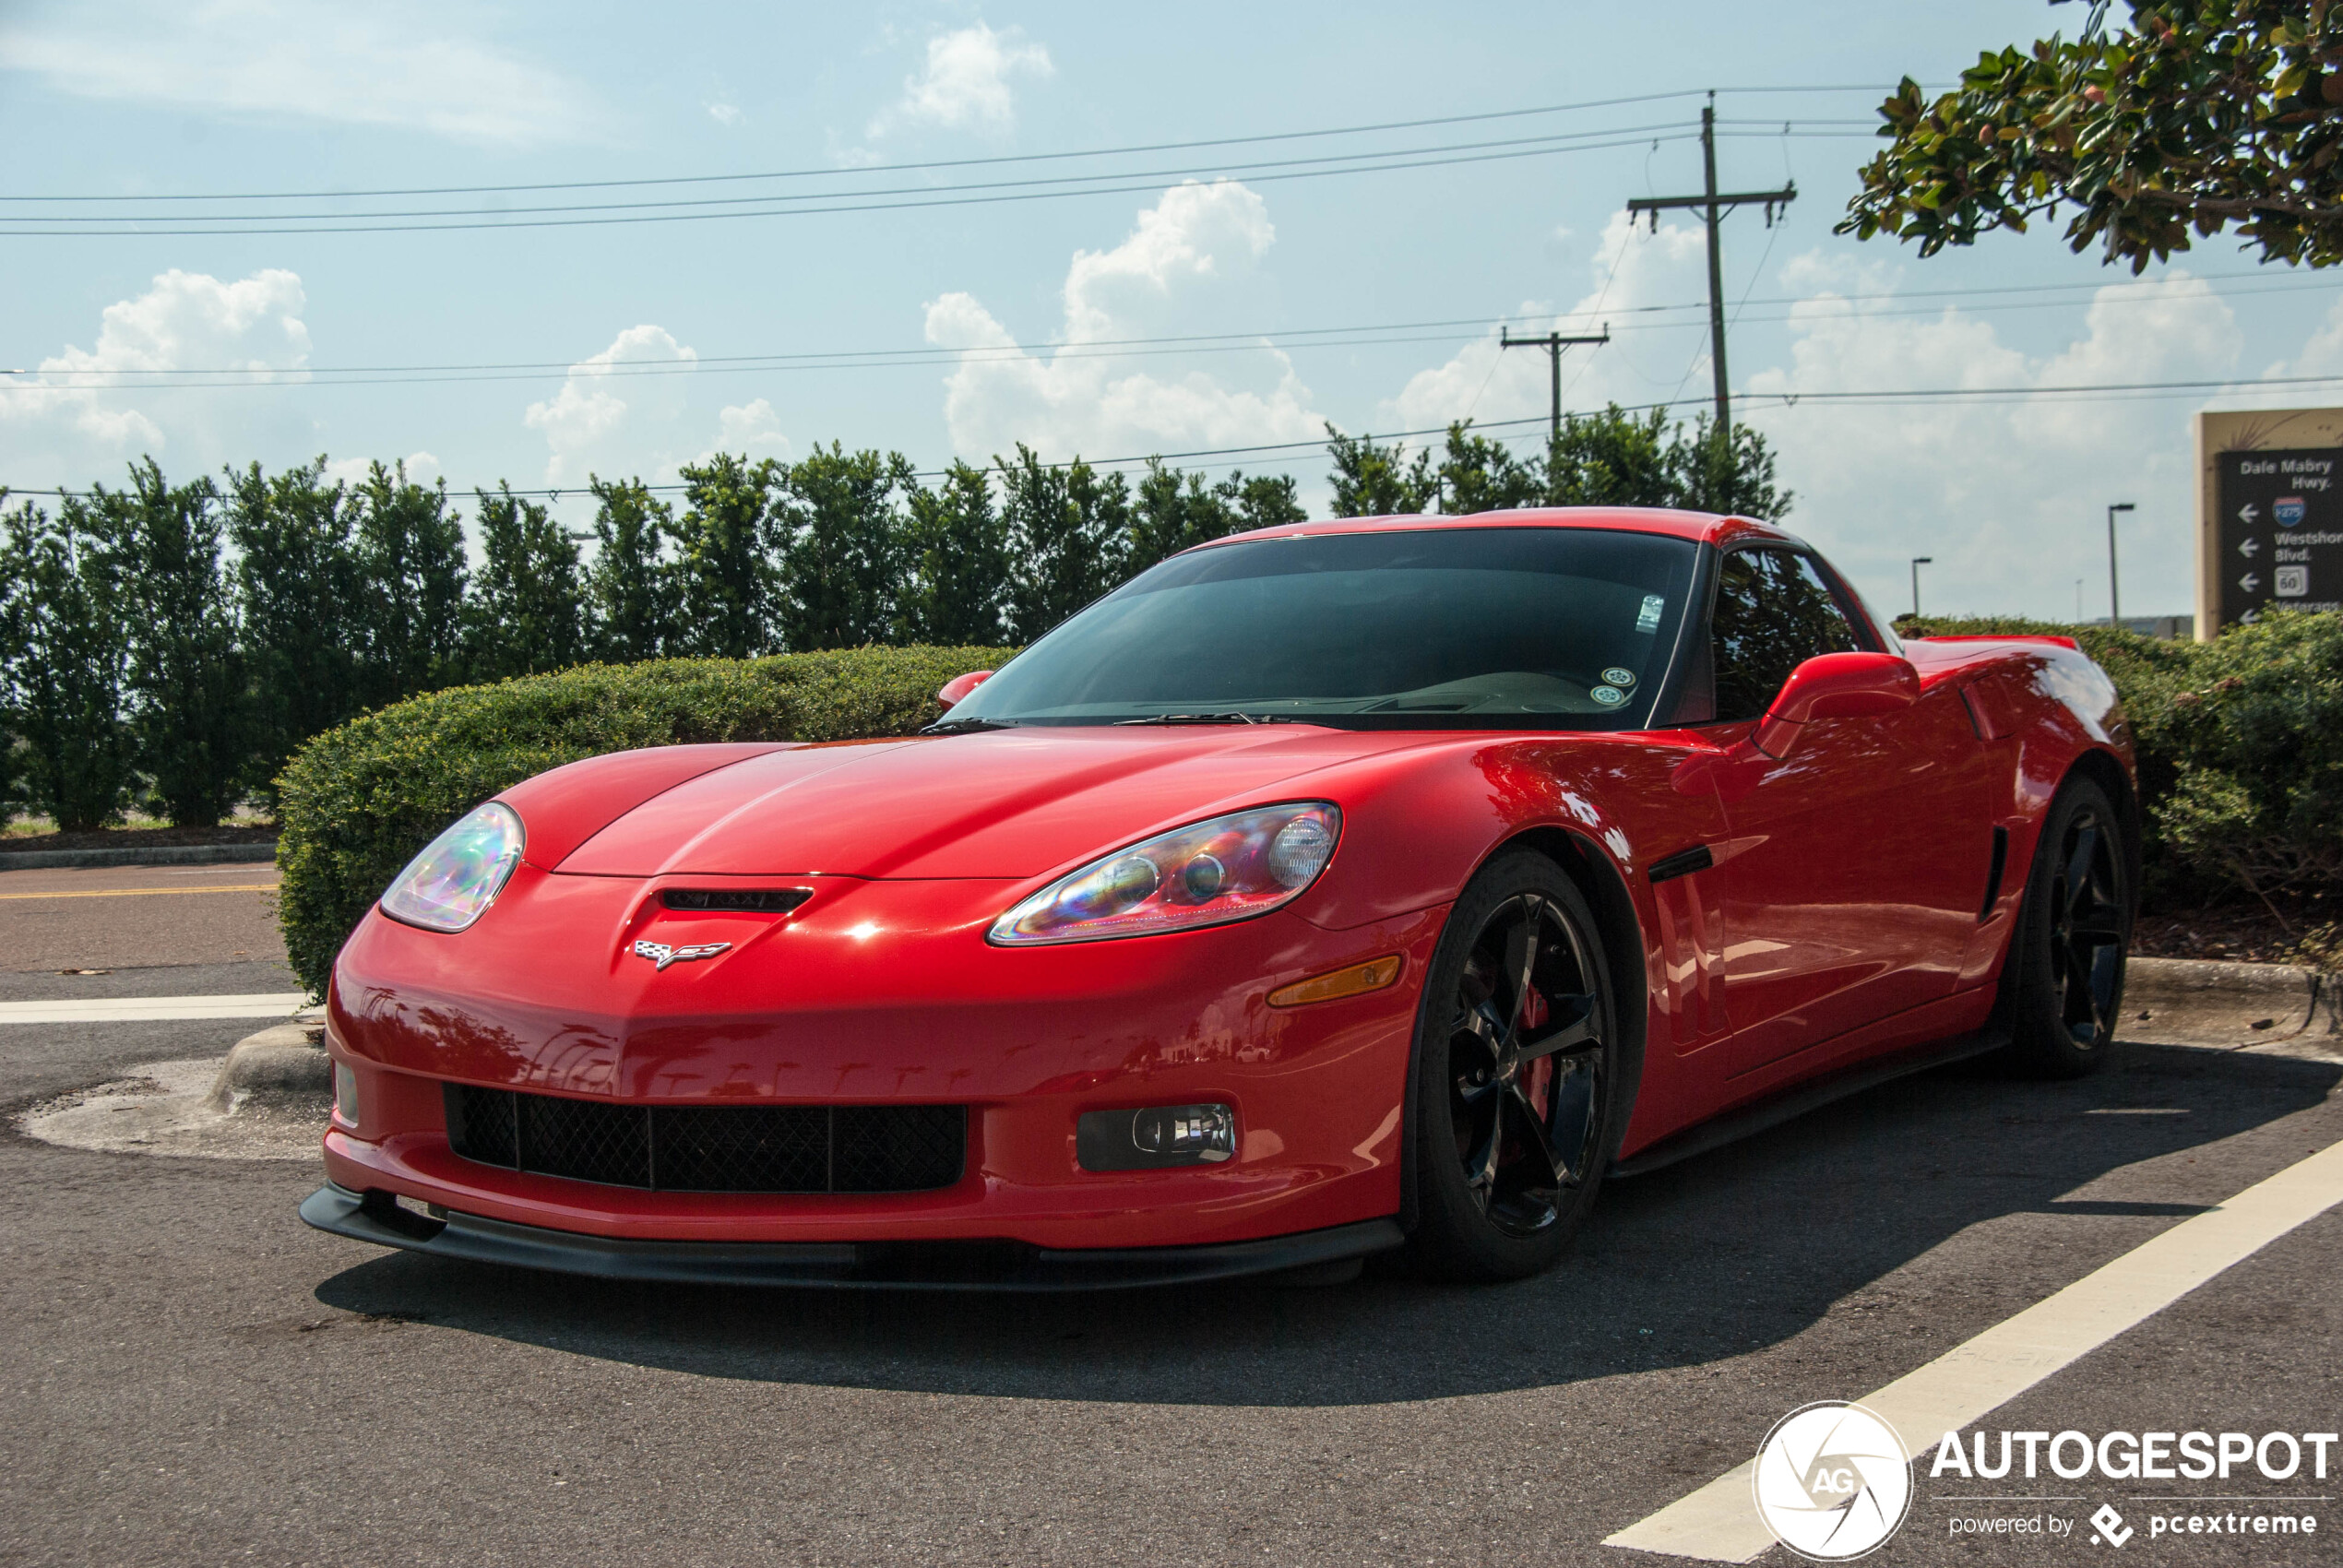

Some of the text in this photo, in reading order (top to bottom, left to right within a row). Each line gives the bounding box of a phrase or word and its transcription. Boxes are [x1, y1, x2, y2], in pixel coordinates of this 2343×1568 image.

[2241, 458, 2333, 475] Dale Mabry
[2292, 476, 2332, 492] Hwy.
[2275, 547, 2312, 562] Blvd.
[2279, 578, 2297, 589] 60
